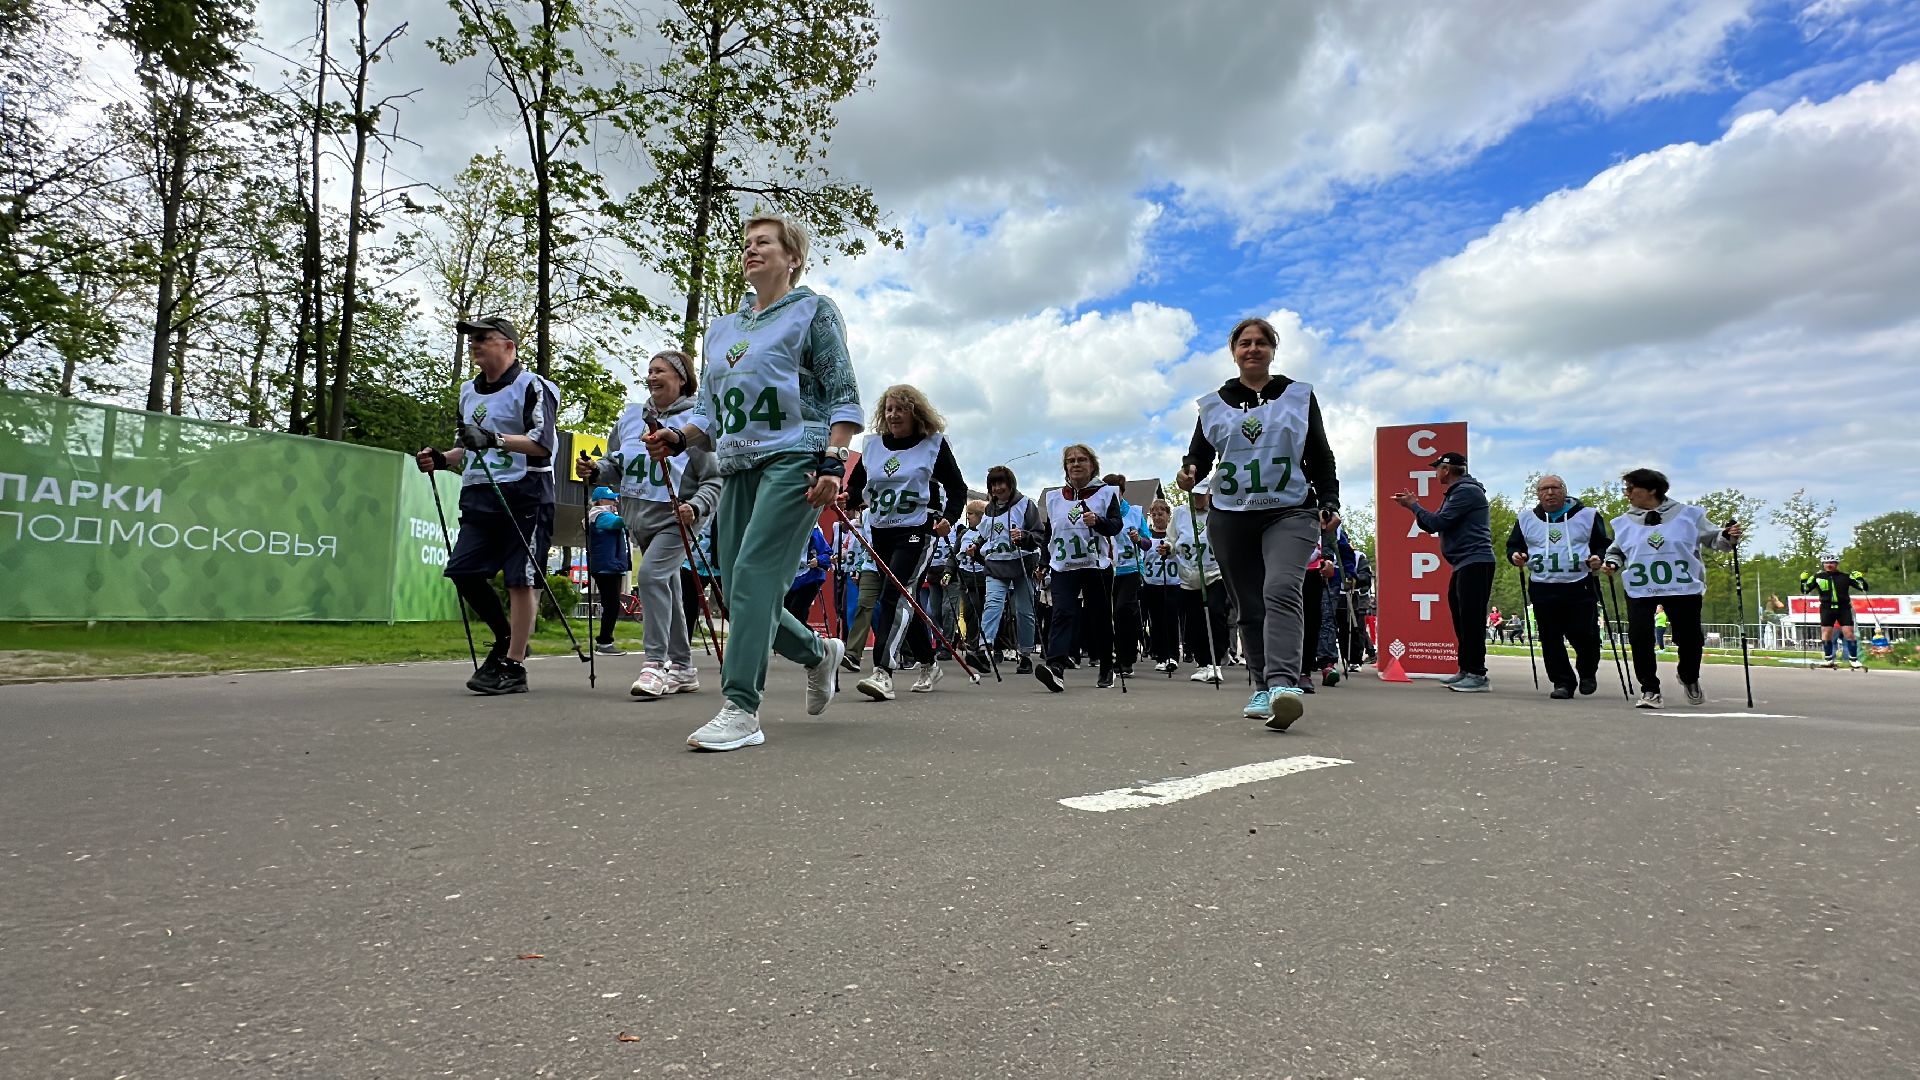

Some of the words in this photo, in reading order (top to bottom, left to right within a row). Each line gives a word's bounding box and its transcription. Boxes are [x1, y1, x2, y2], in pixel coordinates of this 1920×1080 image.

[1216, 456, 1292, 495] 317
[0, 471, 163, 514] ПАРКИ
[868, 488, 920, 516] 395
[1145, 561, 1178, 578] 370
[1531, 552, 1581, 574] 311
[1629, 559, 1694, 587] 303
